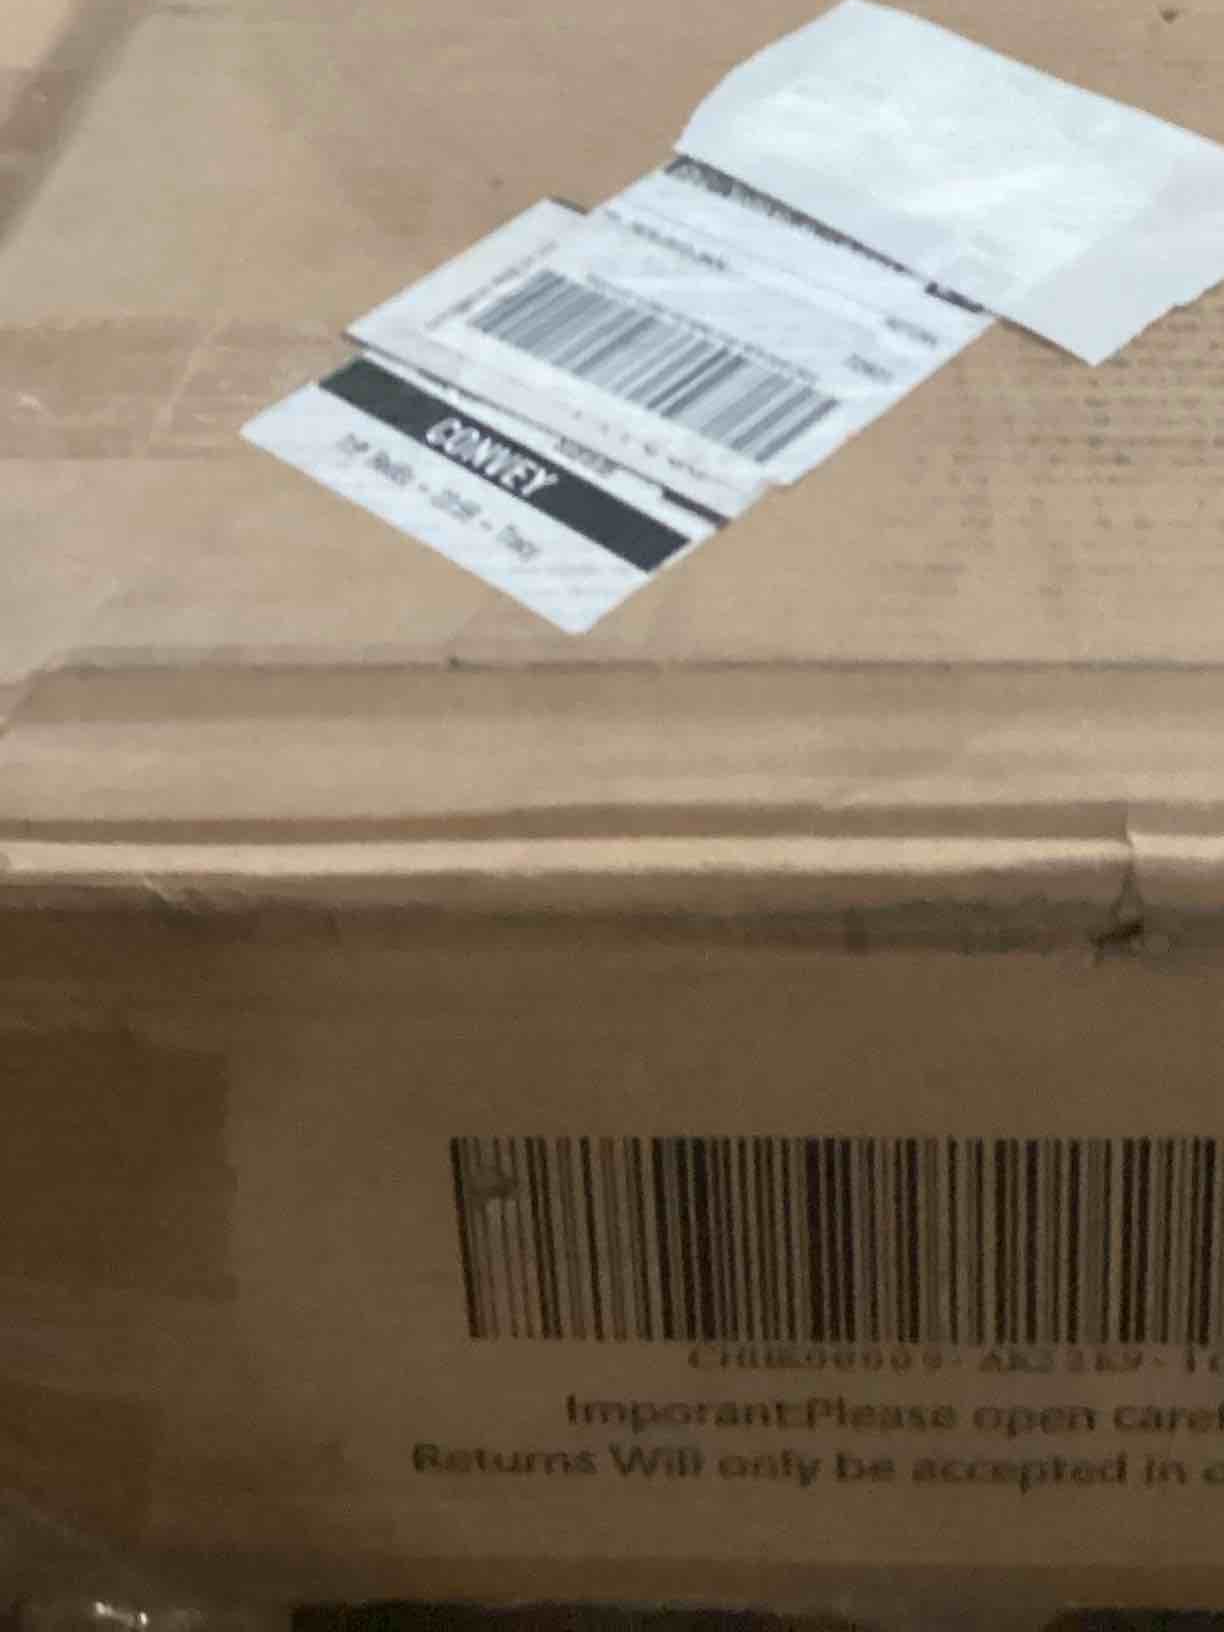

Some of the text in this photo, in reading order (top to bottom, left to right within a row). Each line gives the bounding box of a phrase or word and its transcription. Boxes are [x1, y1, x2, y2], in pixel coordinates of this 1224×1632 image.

[425, 416, 559, 496] CONVEY
[975, 1404, 1097, 1439] open
[411, 1443, 599, 1476] Returns
[608, 1443, 702, 1479] Will
[717, 1447, 823, 1488] only
[835, 1450, 896, 1482] be
[913, 1452, 1127, 1495] accepted
[1145, 1454, 1188, 1486] in
